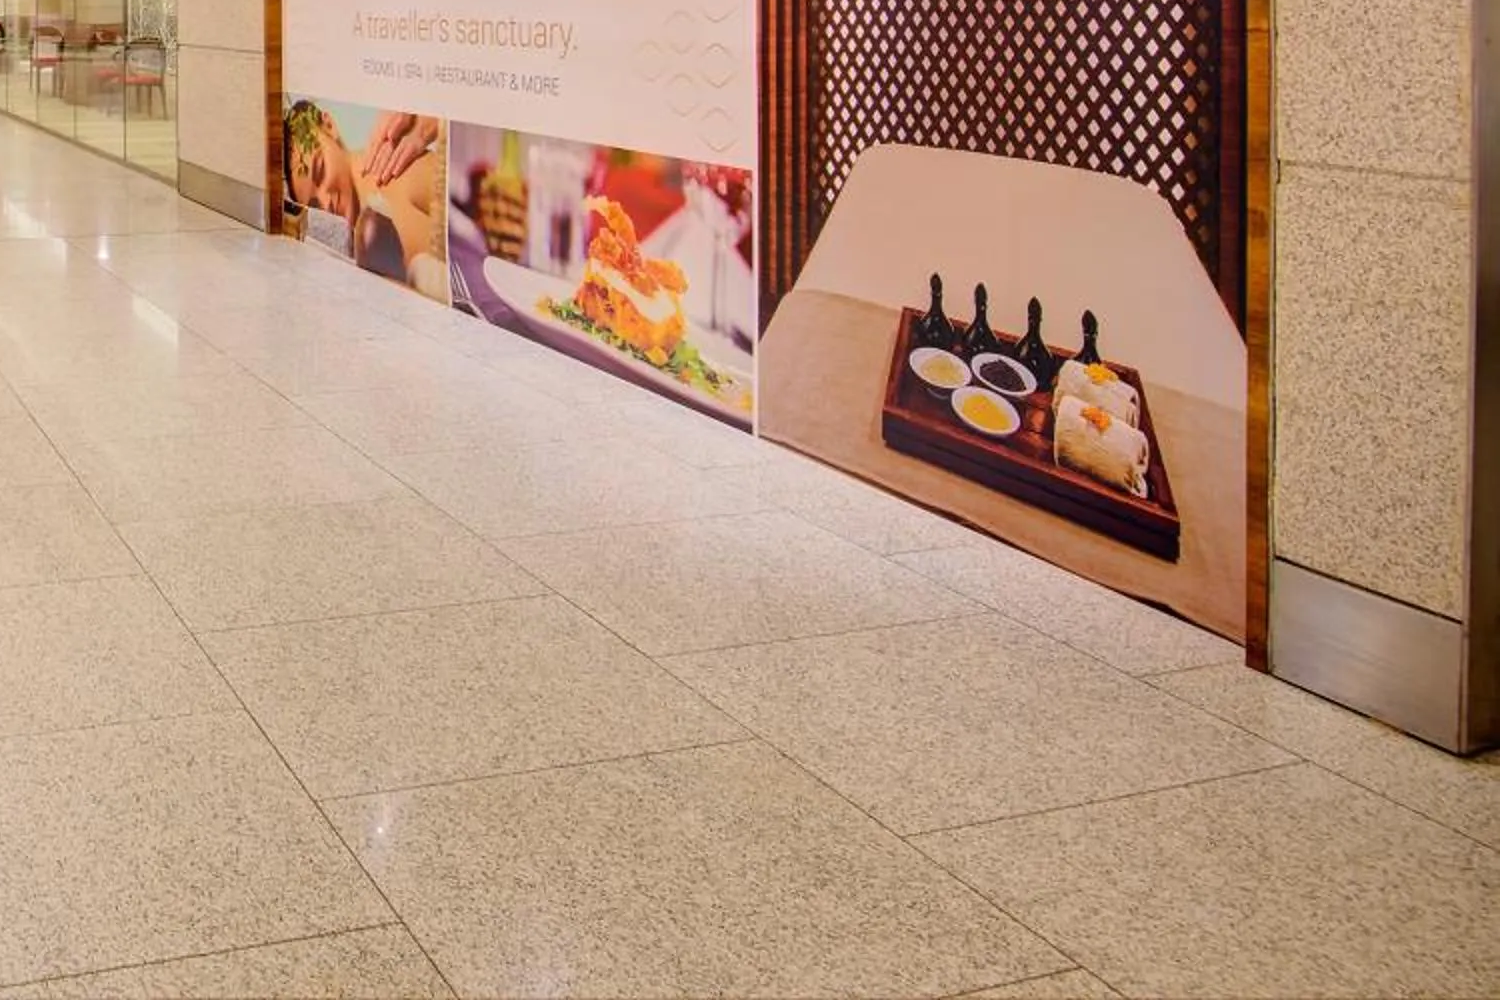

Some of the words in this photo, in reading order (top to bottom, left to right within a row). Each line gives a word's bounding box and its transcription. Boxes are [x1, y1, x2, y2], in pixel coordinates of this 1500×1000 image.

[353, 11, 363, 38] A
[367, 10, 449, 44] traveller's
[455, 15, 578, 60] sanctuary.
[435, 64, 508, 90] RESTAURANT
[509, 72, 519, 92] &
[521, 74, 561, 97] MORE
